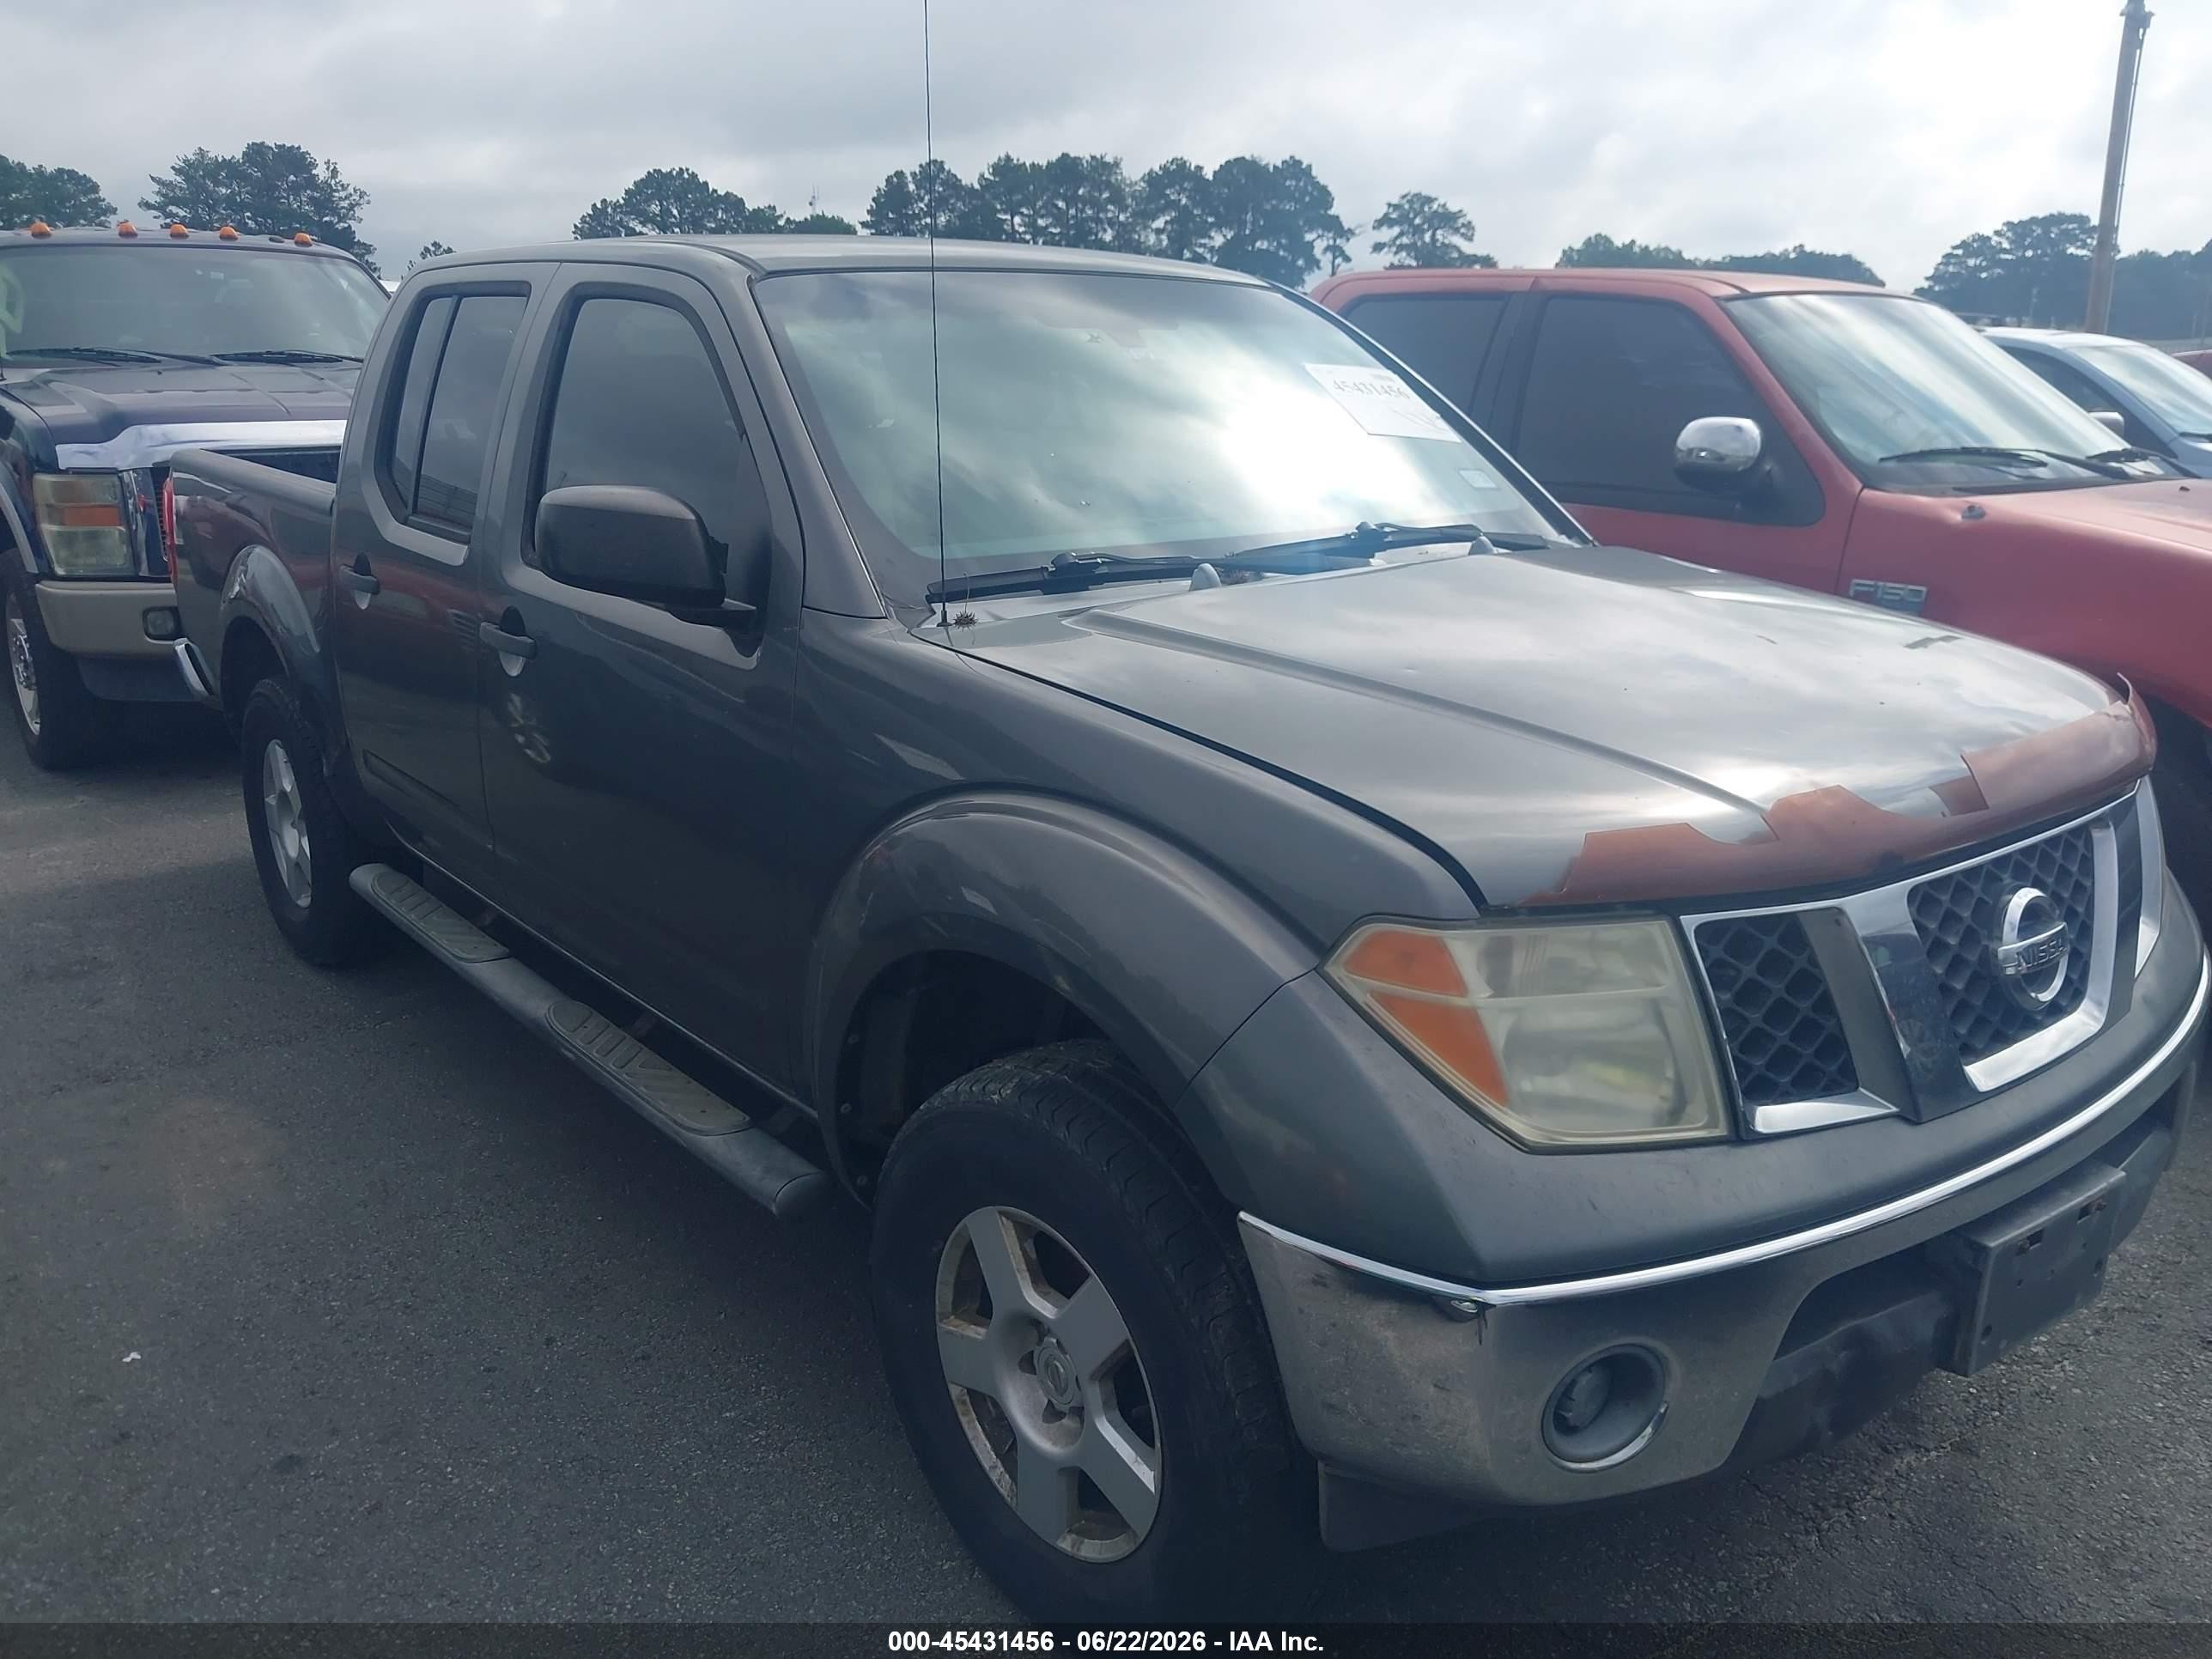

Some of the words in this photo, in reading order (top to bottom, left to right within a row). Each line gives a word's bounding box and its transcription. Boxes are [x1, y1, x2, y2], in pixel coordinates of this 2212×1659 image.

[1333, 380, 1410, 399] 45431456
[1850, 579, 1928, 602] F150
[2015, 938, 2068, 970] NISS
